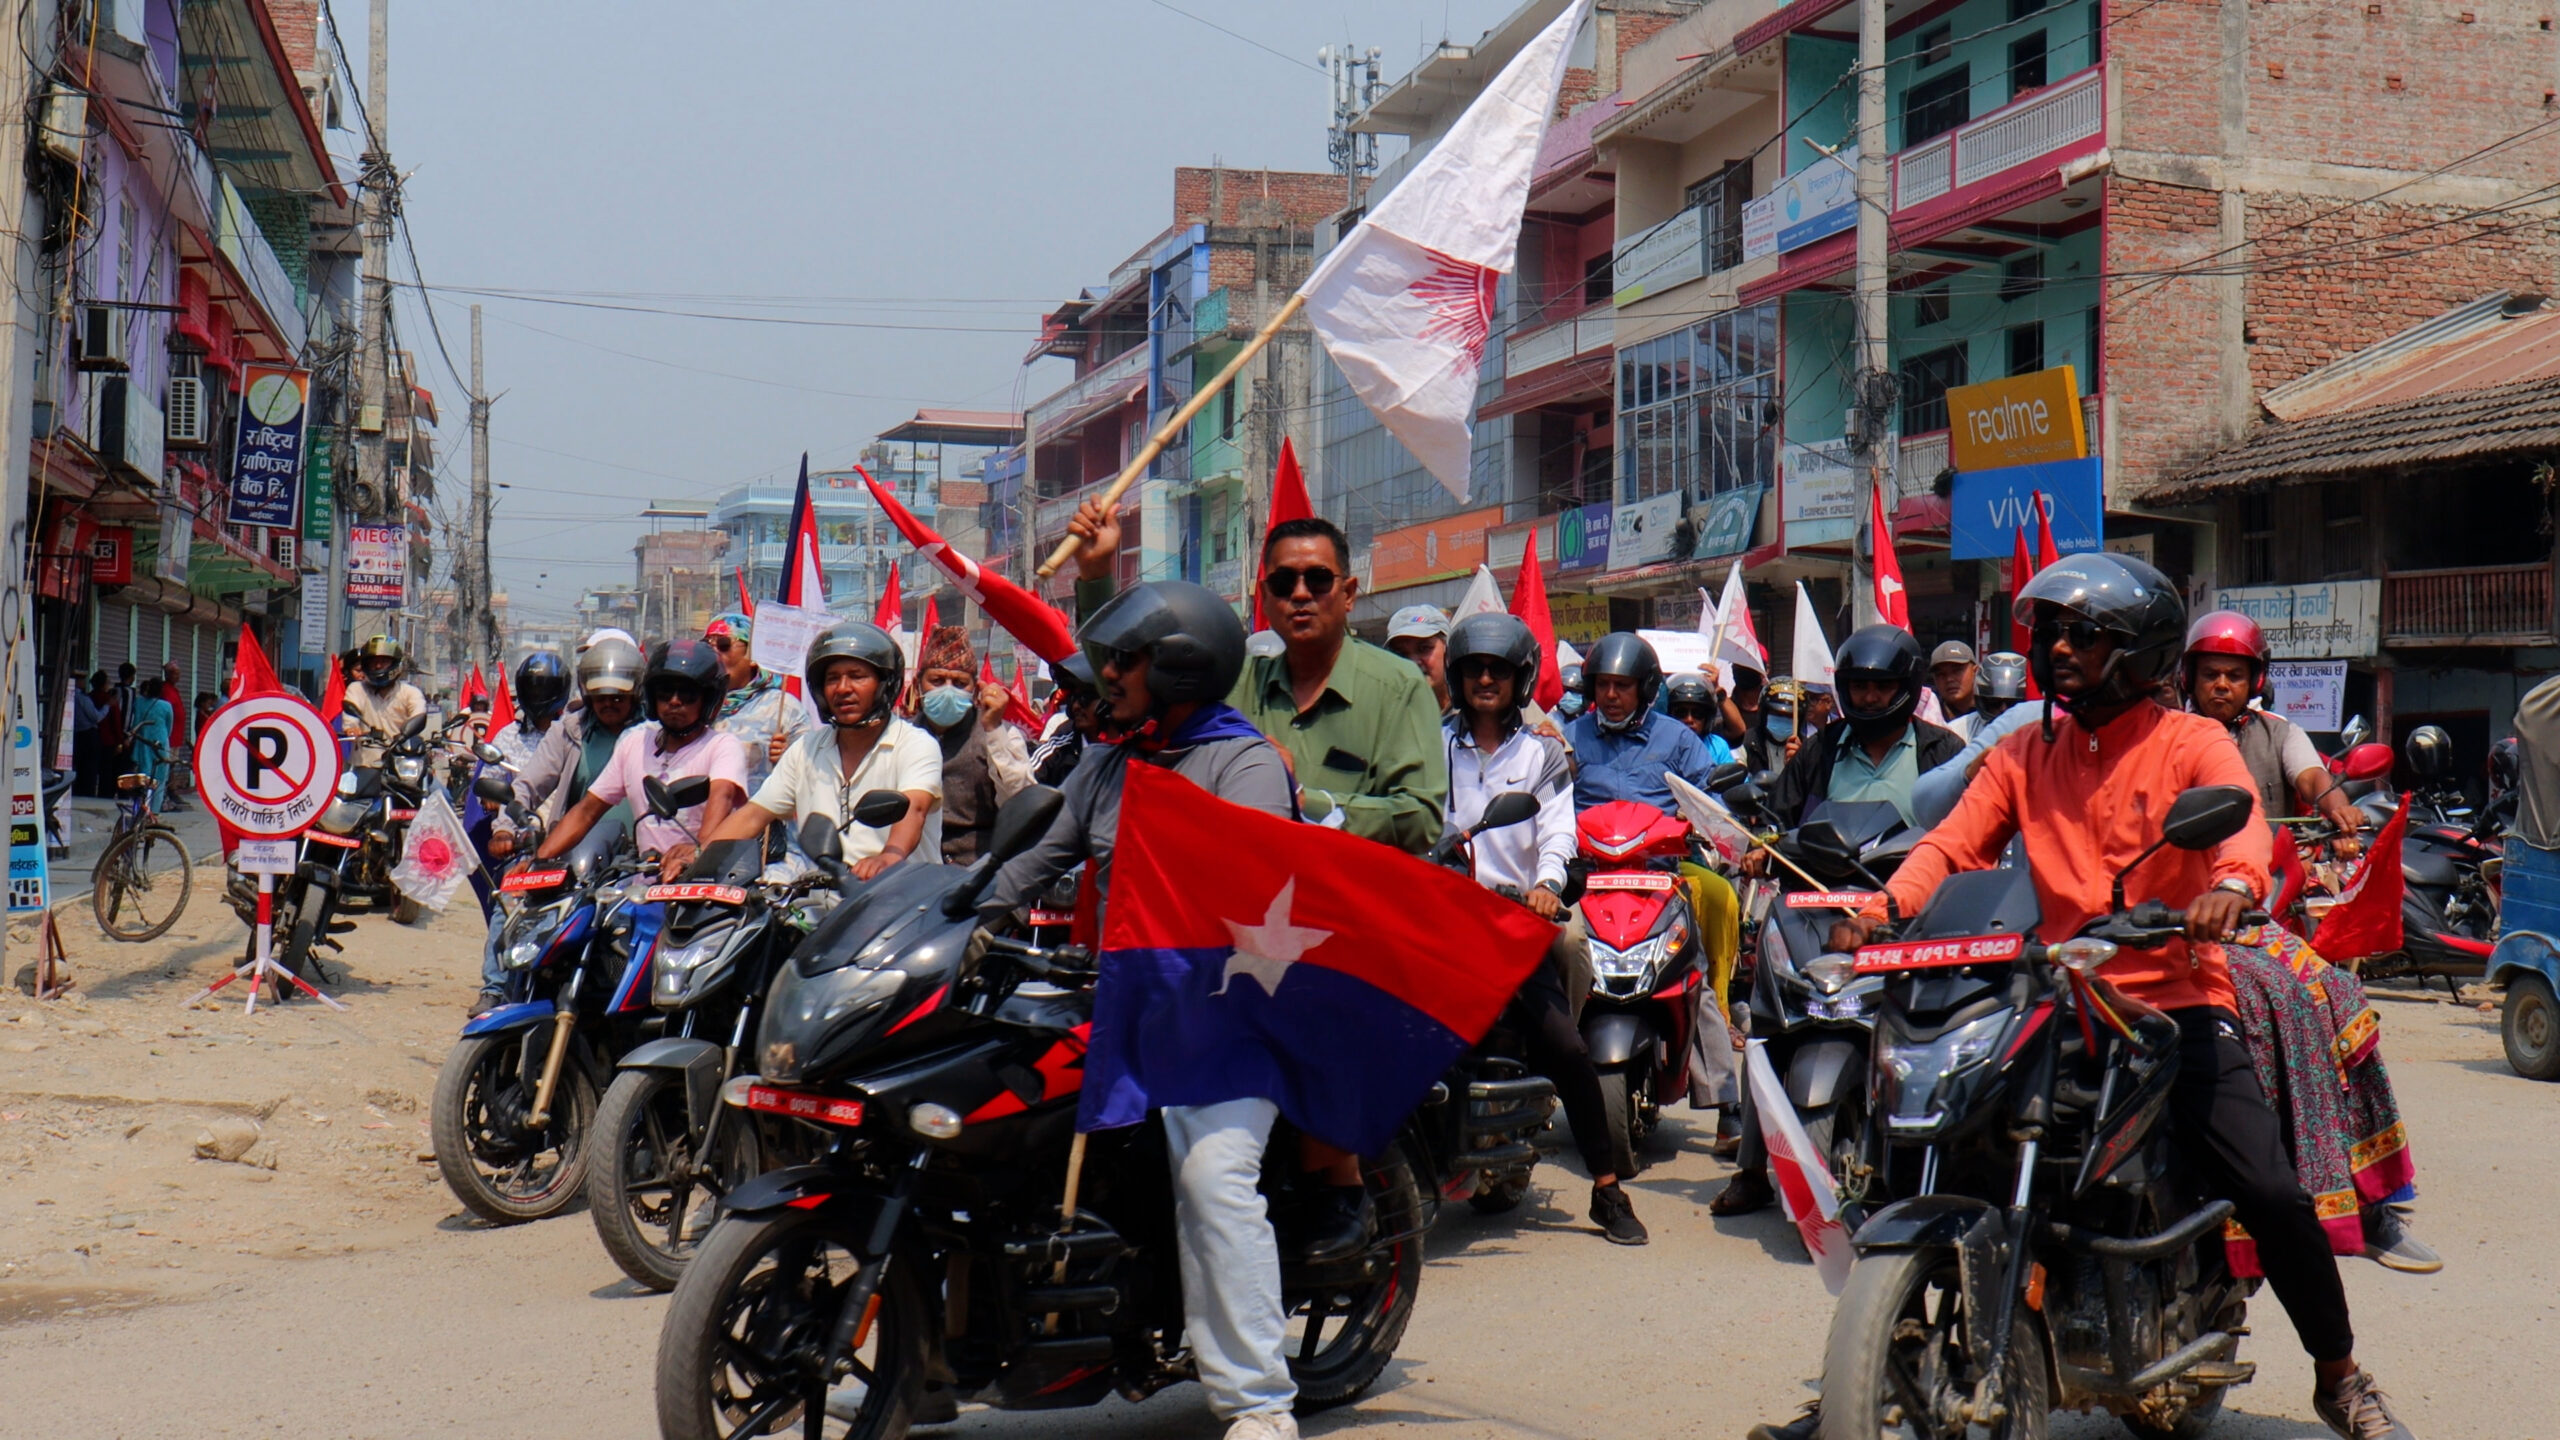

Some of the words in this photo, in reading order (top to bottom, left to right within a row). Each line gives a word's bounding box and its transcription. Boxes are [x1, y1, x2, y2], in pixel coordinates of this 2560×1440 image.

[1968, 396, 2050, 446] realme
[1988, 486, 2055, 529] vivo
[351, 527, 390, 543] KIEC
[352, 574, 376, 583] ELTS
[382, 576, 402, 585] PTE
[2268, 664, 2286, 677] रियर
[247, 726, 288, 790] P
[12, 800, 35, 814] nge
